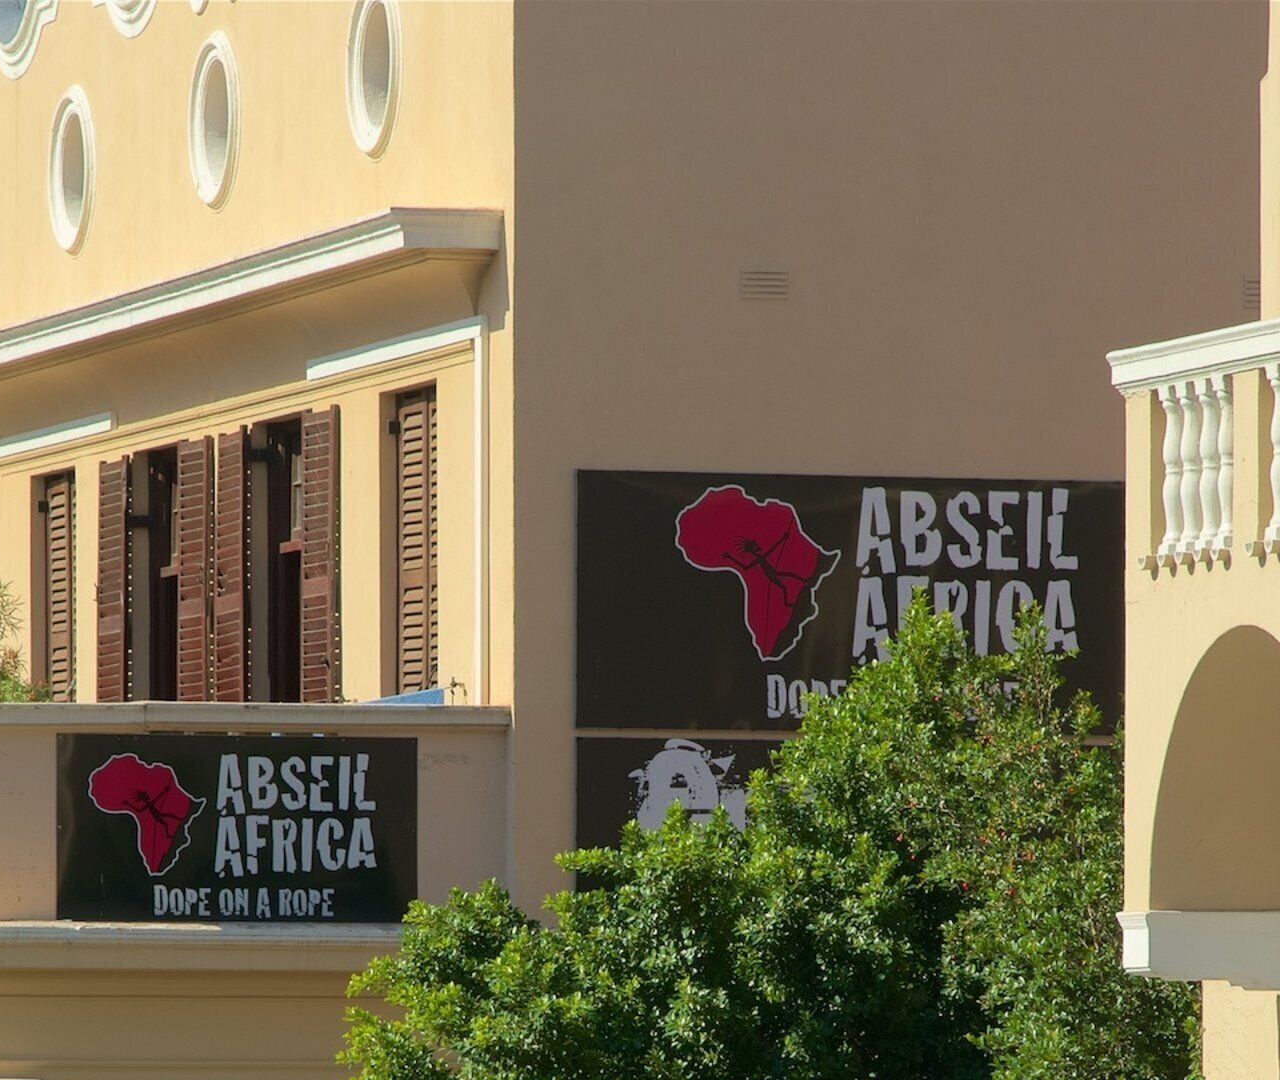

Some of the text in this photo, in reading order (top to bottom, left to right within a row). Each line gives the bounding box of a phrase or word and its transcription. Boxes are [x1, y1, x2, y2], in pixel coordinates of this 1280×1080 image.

[856, 487, 1079, 575] ABSEIL
[216, 753, 376, 815] ABSEIL
[214, 815, 377, 877] AFRICA
[153, 884, 335, 919] DOPE ON A ROPE
